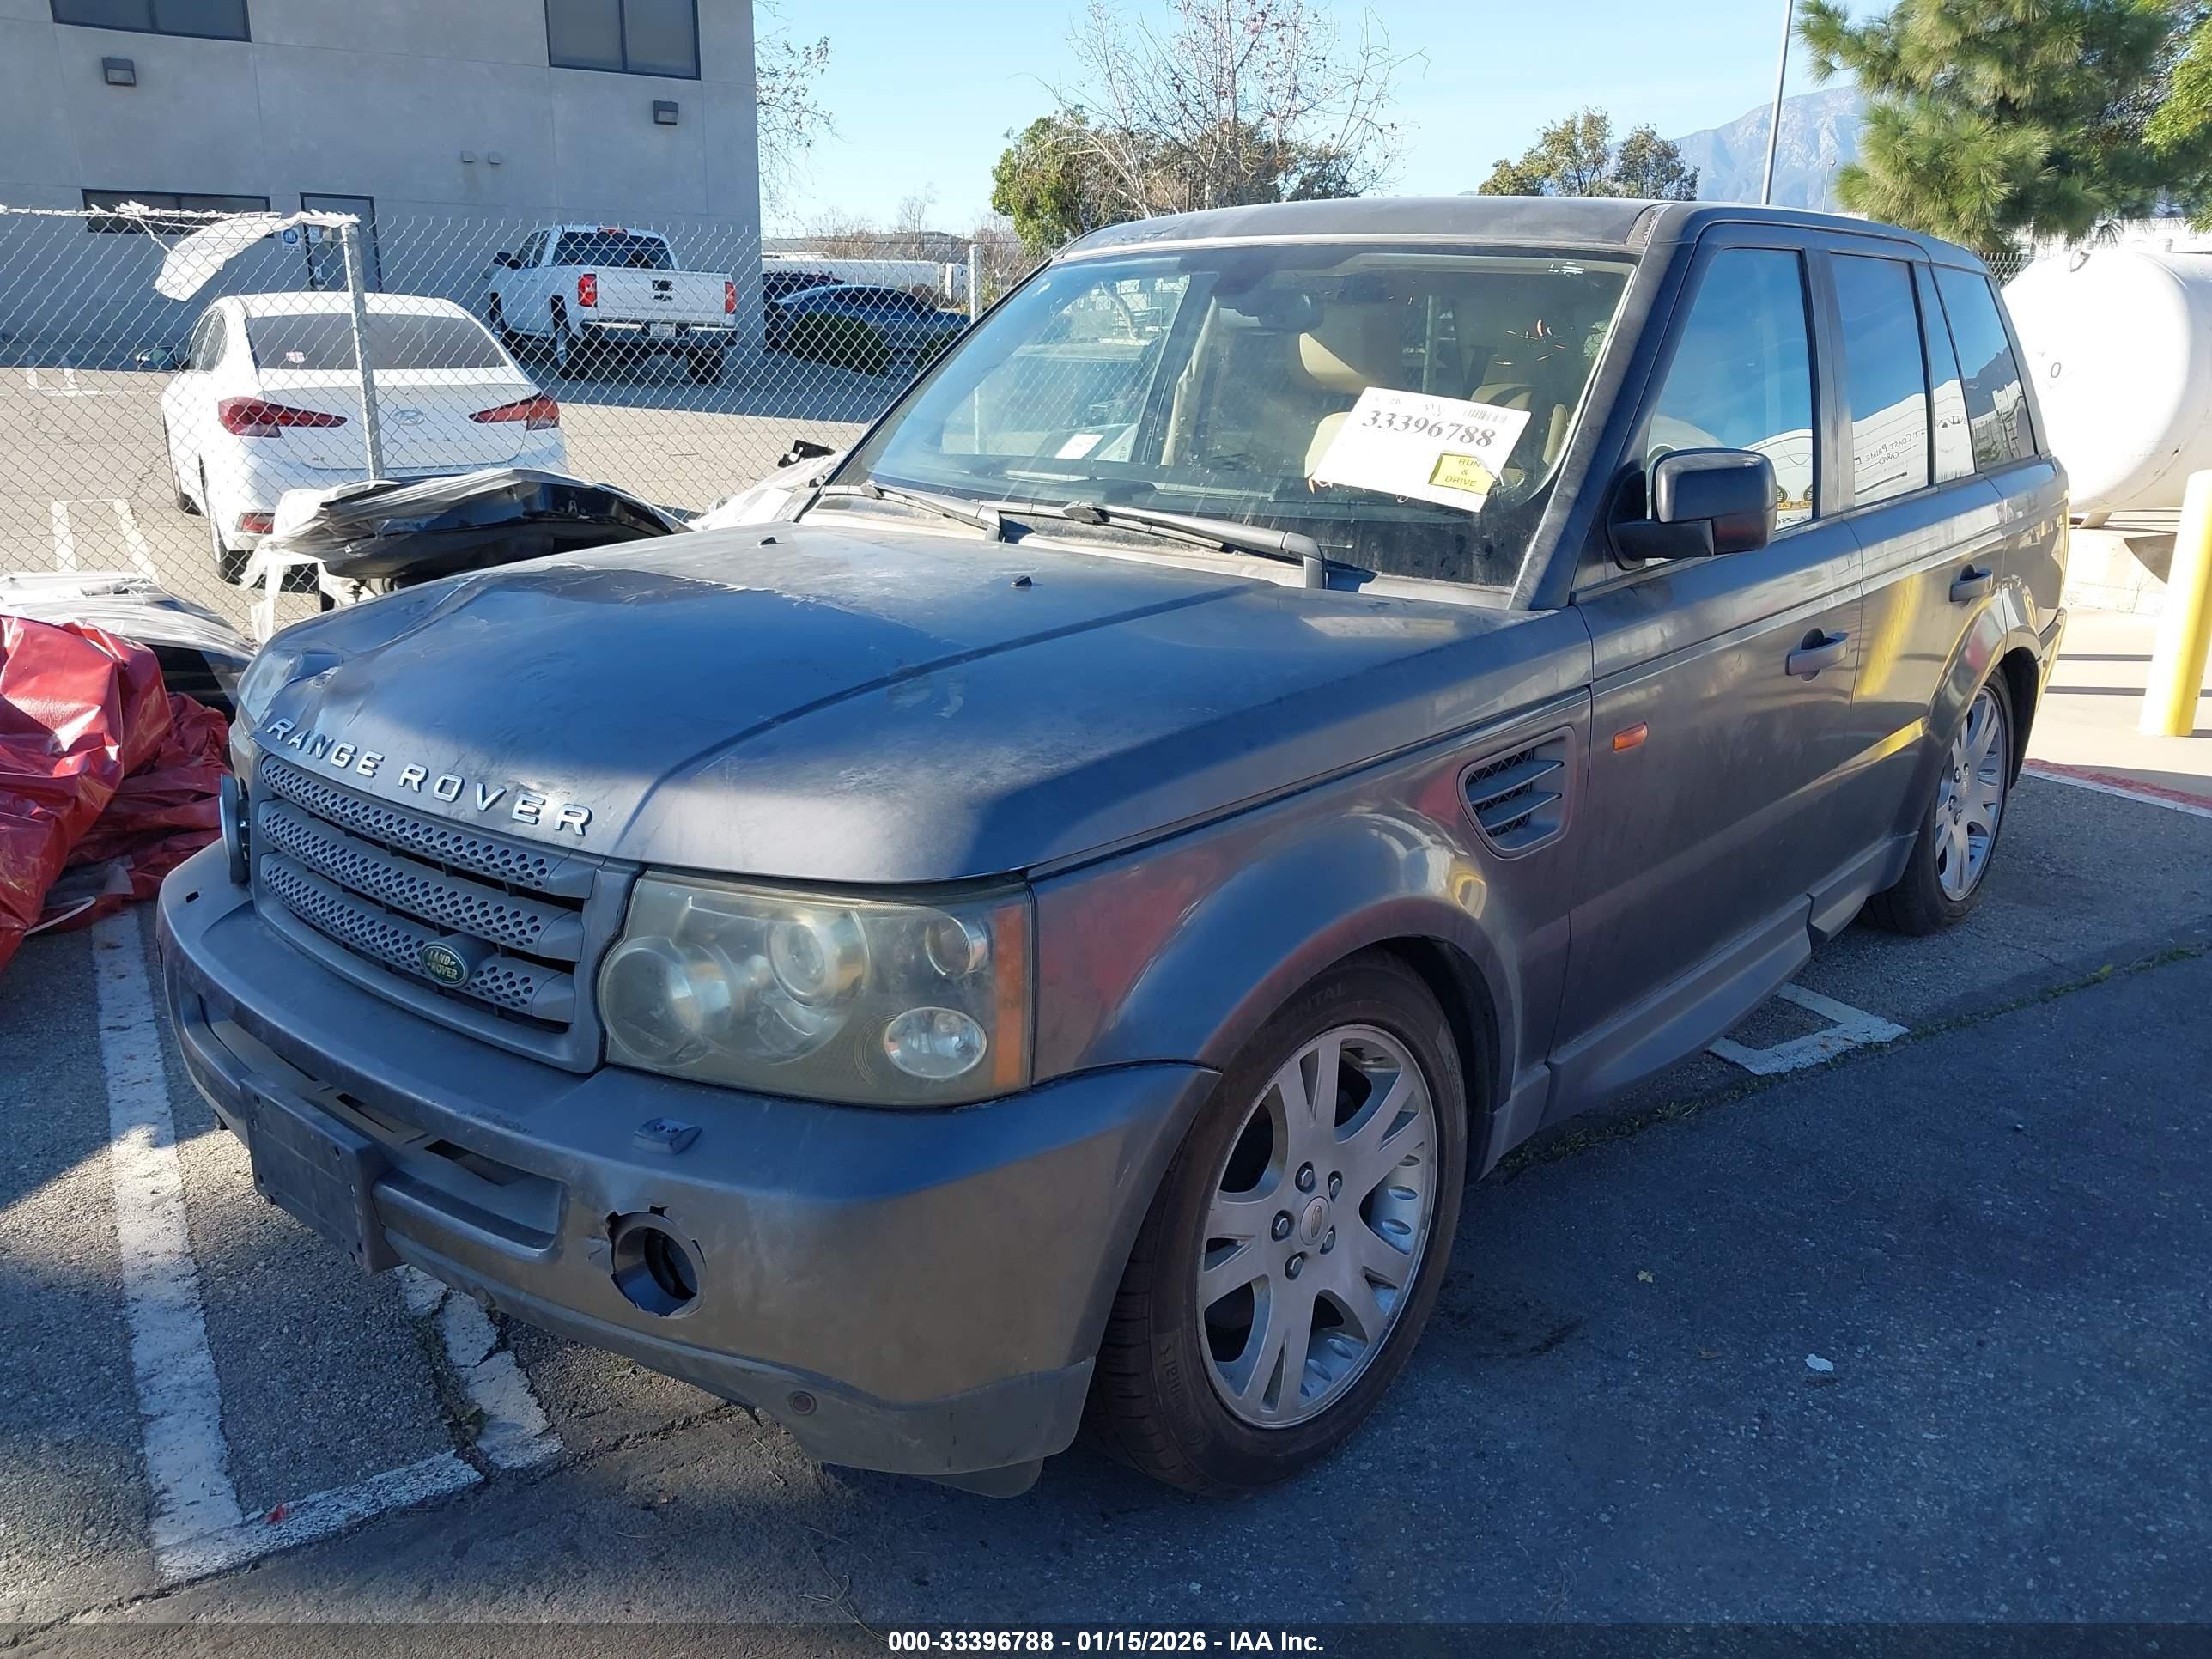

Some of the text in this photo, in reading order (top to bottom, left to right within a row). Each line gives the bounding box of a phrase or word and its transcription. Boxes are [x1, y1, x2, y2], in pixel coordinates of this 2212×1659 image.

[1362, 410, 1496, 447] 33396788
[1458, 458, 1481, 468] RUN
[1444, 475, 1478, 487] DRIVE
[266, 717, 593, 836] RANGE ROVER
[428, 951, 451, 966] LAND
[430, 963, 458, 979] ROVER
